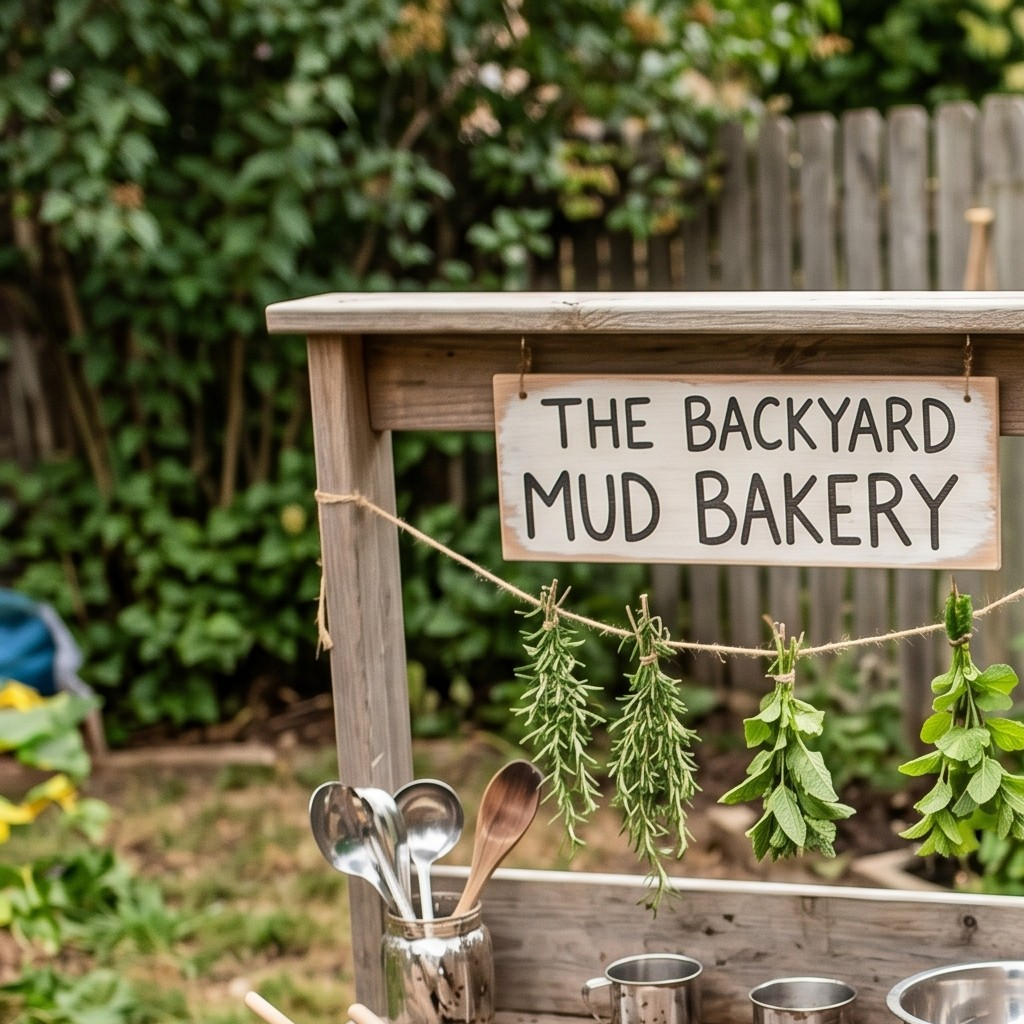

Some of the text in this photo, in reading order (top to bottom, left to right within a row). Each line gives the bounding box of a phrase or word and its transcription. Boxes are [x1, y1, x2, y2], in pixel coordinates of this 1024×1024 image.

[541, 395, 956, 453] THE BACKYARD
[523, 470, 959, 550] MUD BAKERY
